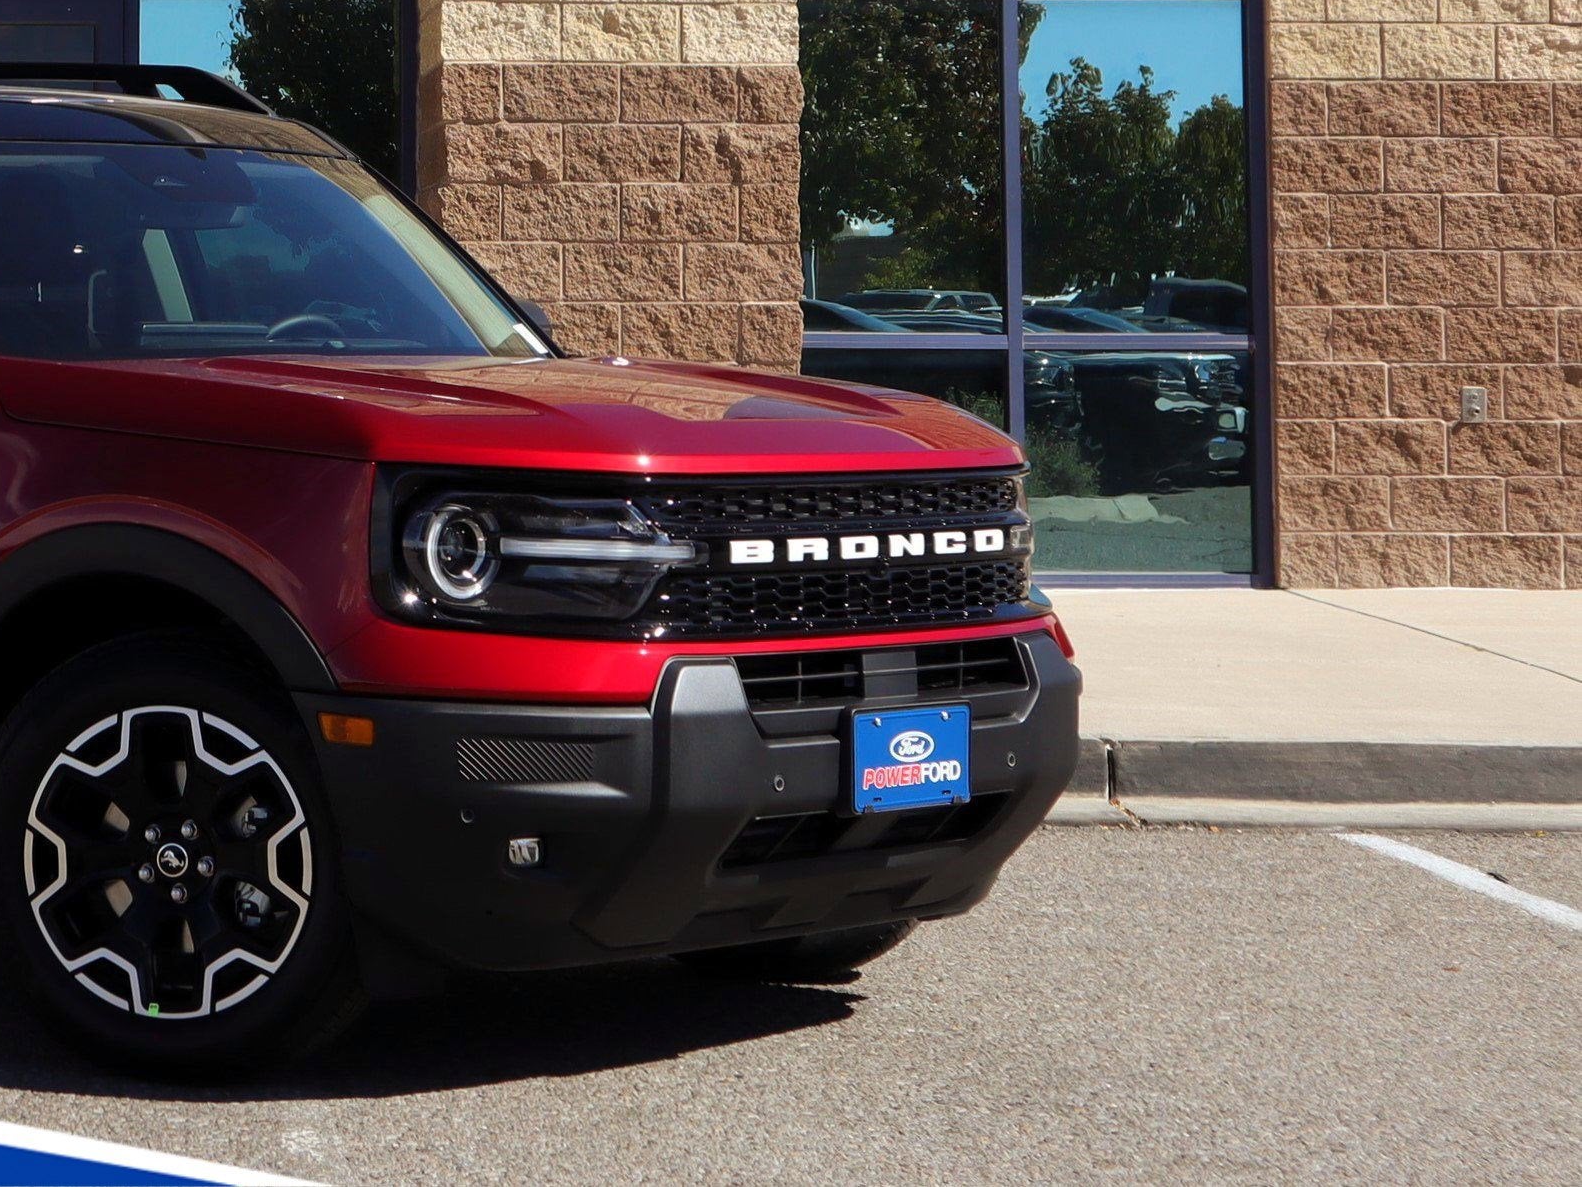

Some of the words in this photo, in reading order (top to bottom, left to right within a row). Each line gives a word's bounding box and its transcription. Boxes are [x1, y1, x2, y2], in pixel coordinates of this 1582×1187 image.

[729, 528, 1005, 564] BRONCO
[897, 736, 926, 756] Ford
[862, 760, 962, 790] POWERFORD
